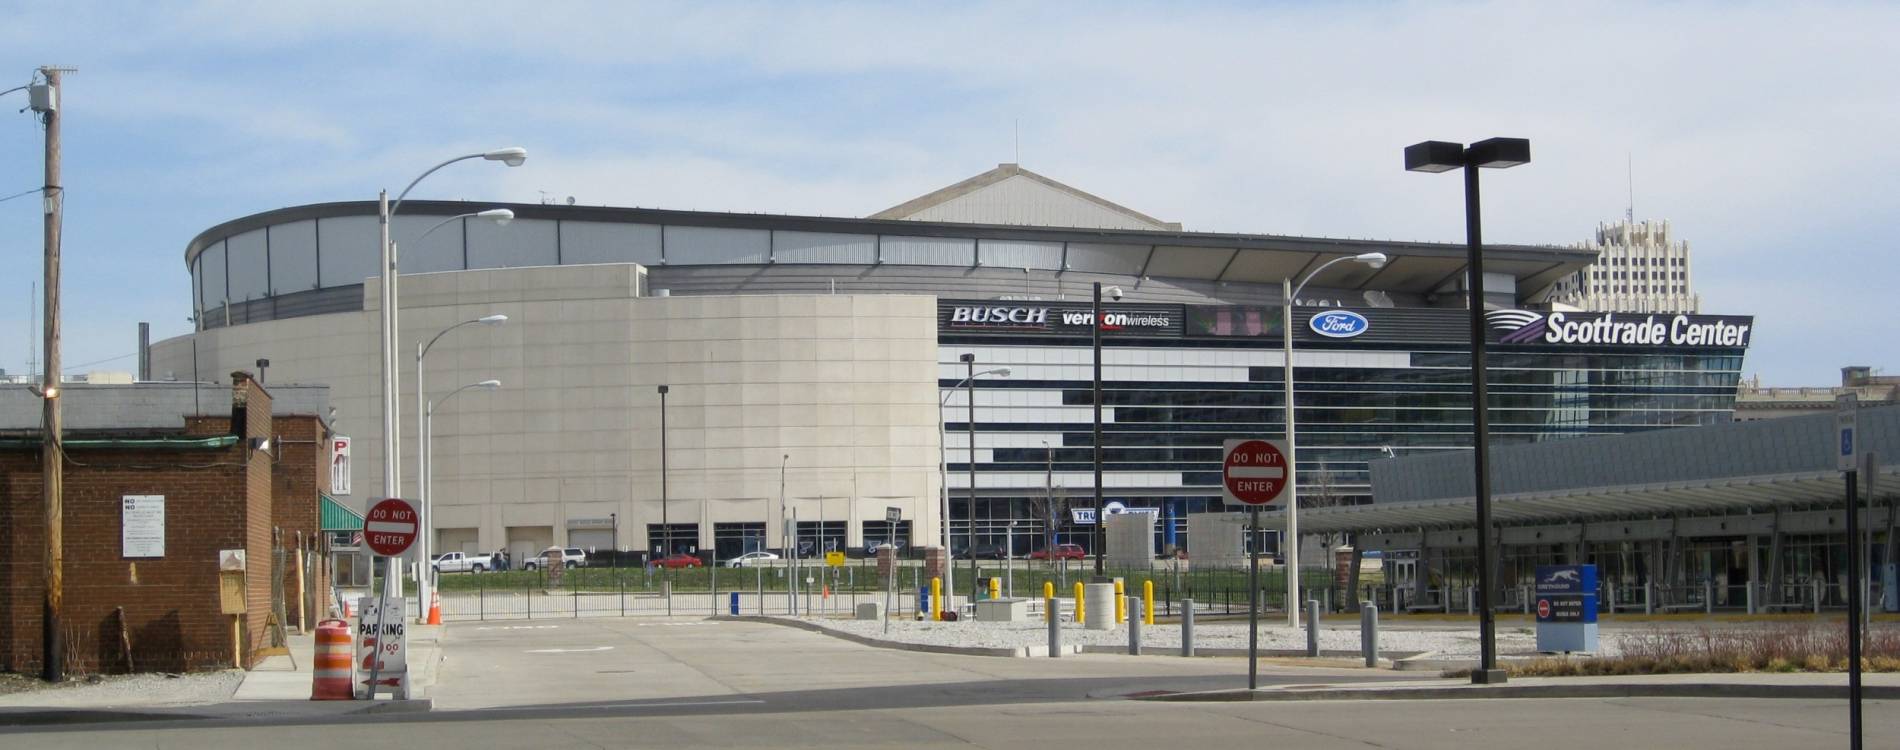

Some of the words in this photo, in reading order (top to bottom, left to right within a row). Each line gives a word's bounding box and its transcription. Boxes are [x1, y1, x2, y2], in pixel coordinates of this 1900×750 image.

[952, 306, 1048, 323] BUSCH
[1322, 315, 1356, 331] Ford
[1545, 312, 1666, 345] Scottrade
[1670, 315, 1749, 346] Center
[1233, 453, 1248, 463] DO
[1255, 453, 1278, 463] NOT
[1237, 481, 1273, 492] ENTER
[373, 509, 386, 519] DO
[392, 510, 411, 520] NOT
[374, 534, 404, 544] ENTER
